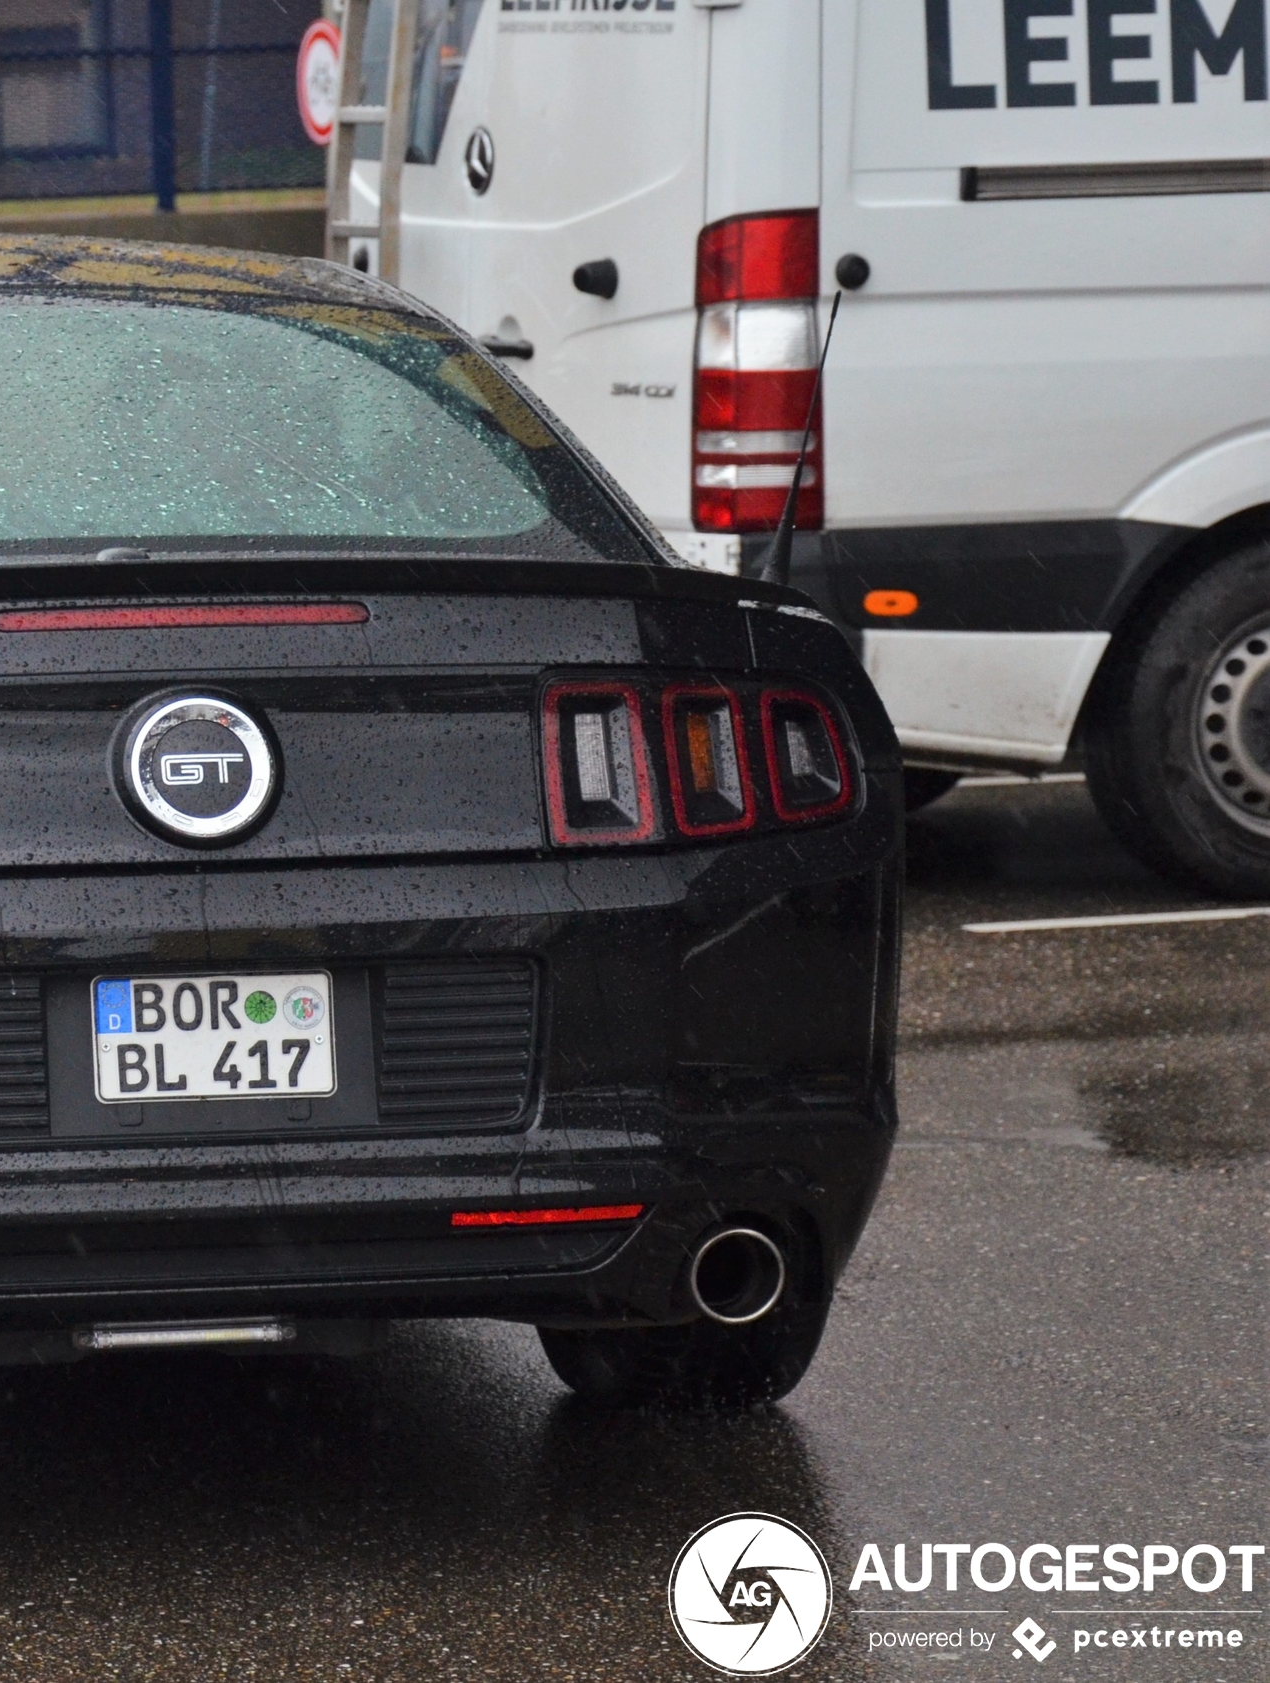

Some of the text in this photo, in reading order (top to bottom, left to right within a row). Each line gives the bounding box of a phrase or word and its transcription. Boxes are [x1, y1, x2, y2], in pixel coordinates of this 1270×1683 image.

[160, 753, 244, 786] GT
[109, 981, 241, 1032] D BOR
[117, 1039, 311, 1092] BL 417
